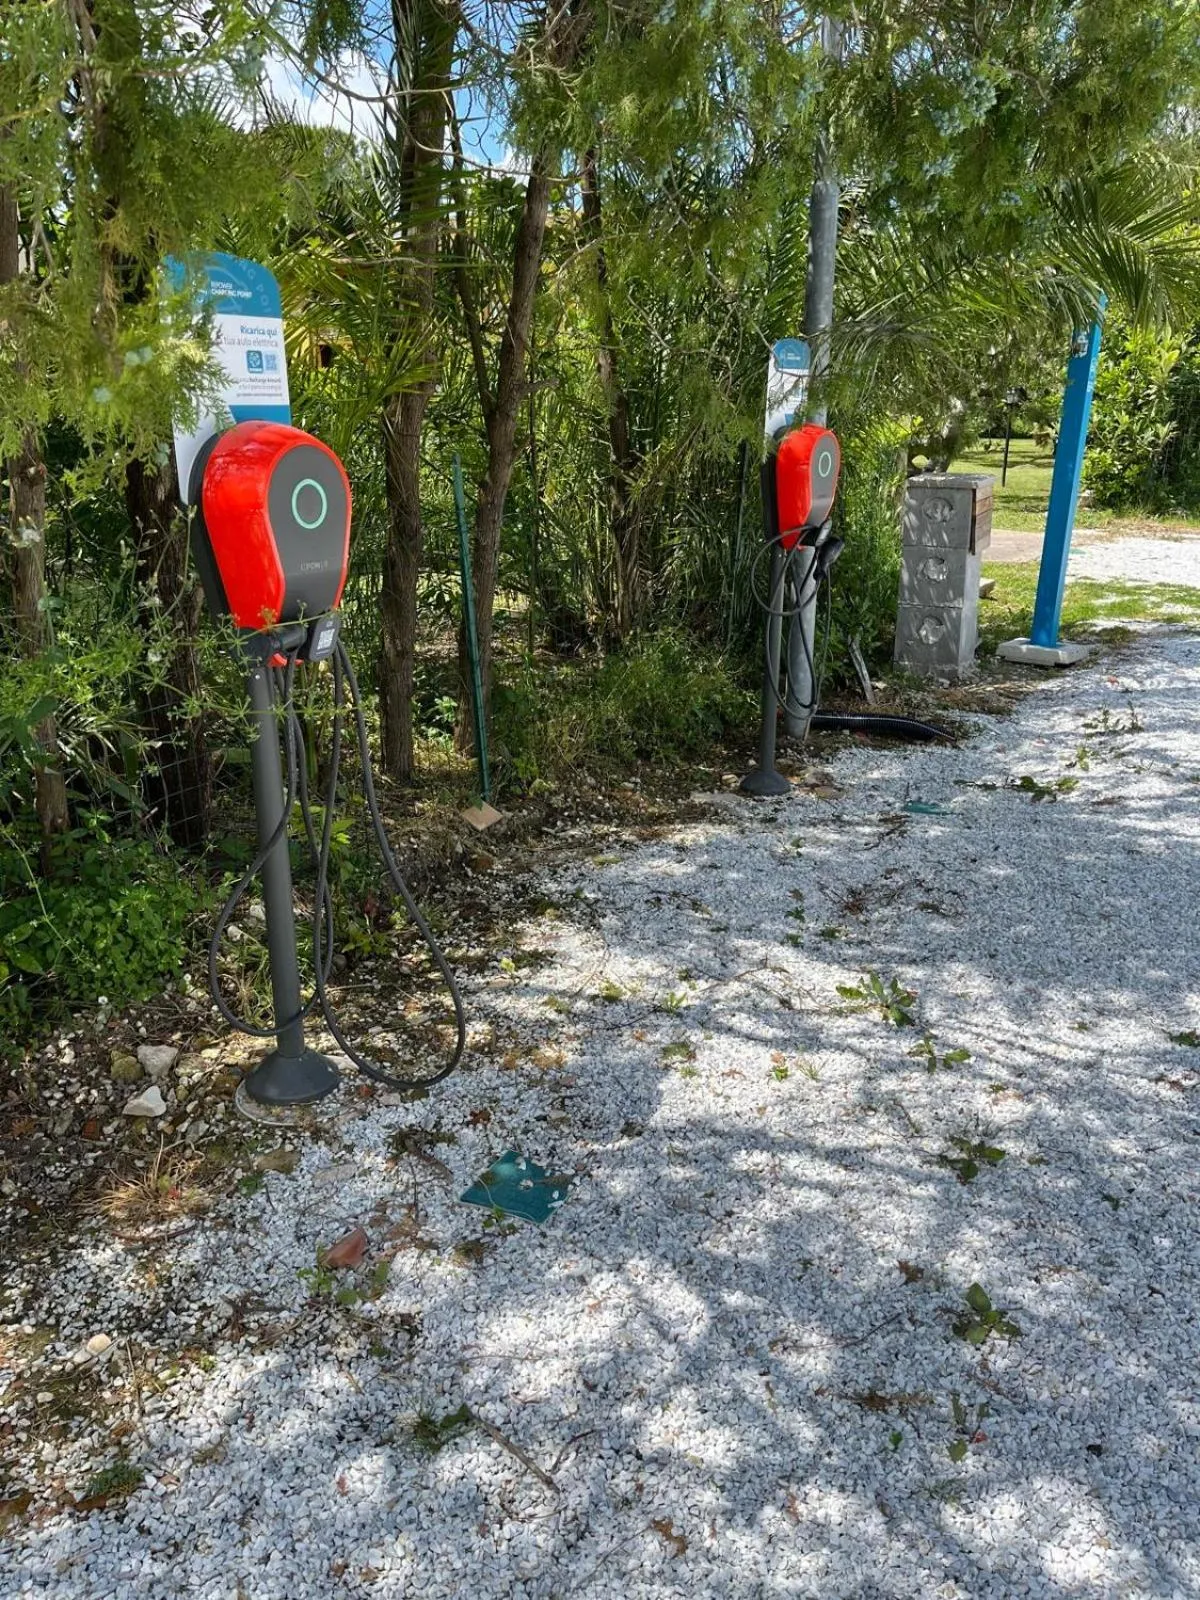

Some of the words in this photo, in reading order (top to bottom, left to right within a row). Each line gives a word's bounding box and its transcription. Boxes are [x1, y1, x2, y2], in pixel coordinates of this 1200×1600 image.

[240, 325, 266, 335] Ricarica
[267, 327, 278, 338] qui
[236, 336, 252, 346] auto
[253, 337, 278, 347] elettrica
